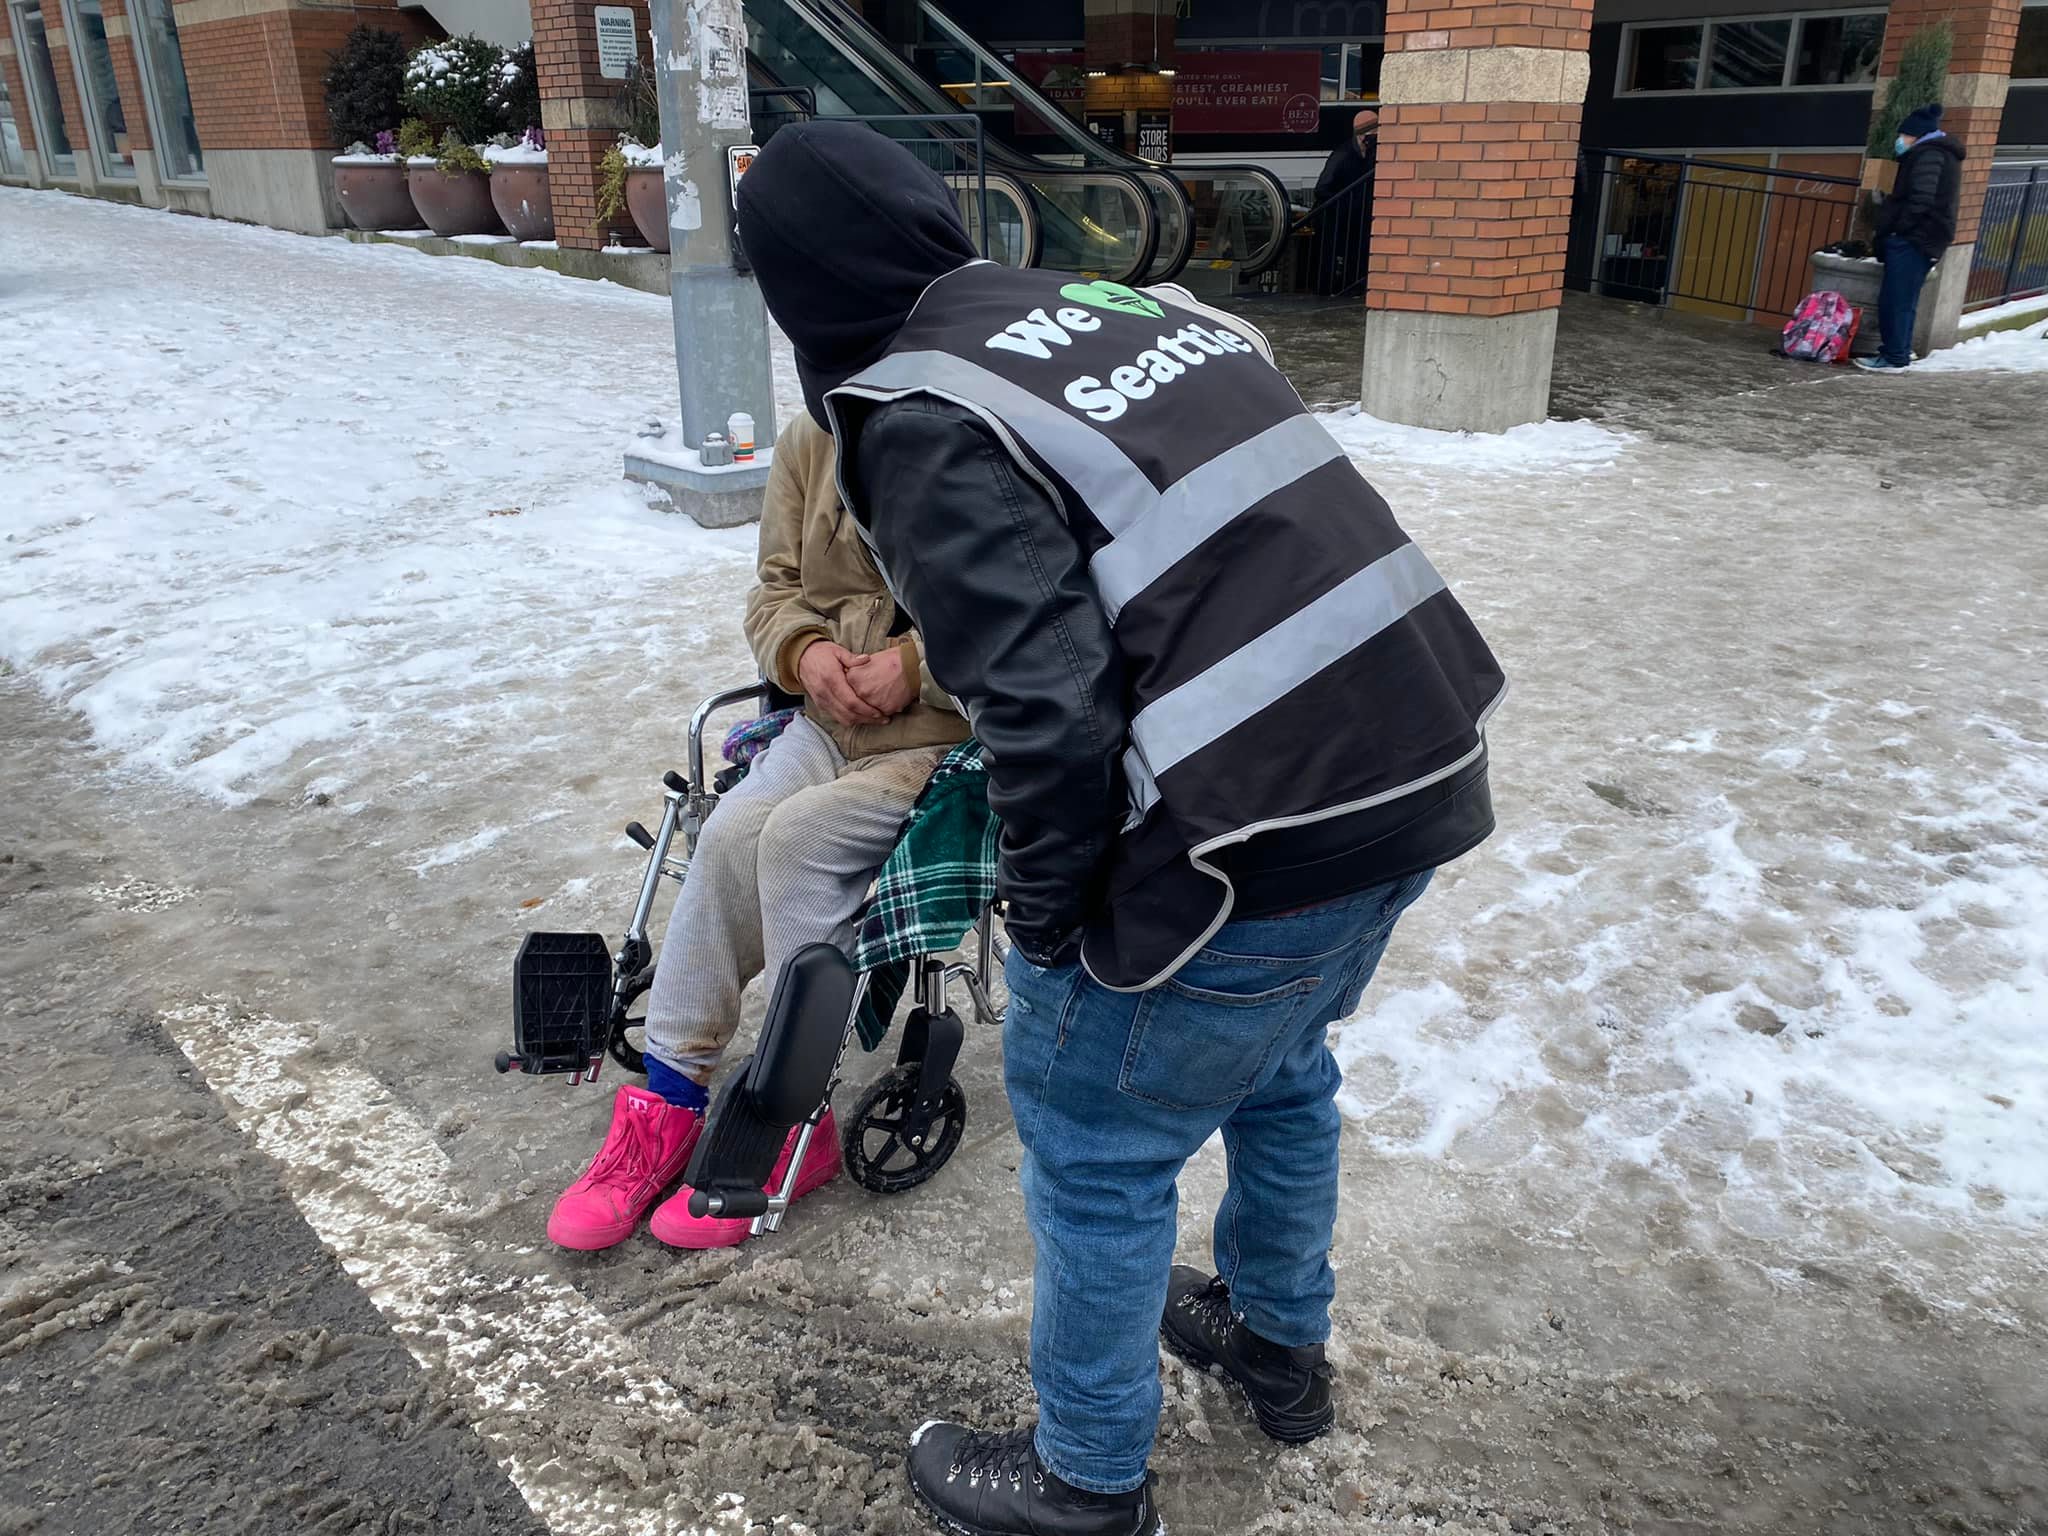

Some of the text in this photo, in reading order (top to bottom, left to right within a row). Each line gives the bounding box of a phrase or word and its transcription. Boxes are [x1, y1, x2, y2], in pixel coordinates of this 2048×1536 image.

[600, 18, 631, 27] WARNING
[1173, 83, 1288, 94] ETEST, CREAMIEST
[1216, 96, 1246, 105] EVER
[1251, 95, 1278, 105] EAT!
[1288, 109, 1316, 119] BEST
[1140, 129, 1168, 146] STORE
[1139, 147, 1168, 162] HOURS
[984, 307, 1102, 360] We
[1064, 323, 1253, 422] Seattle
